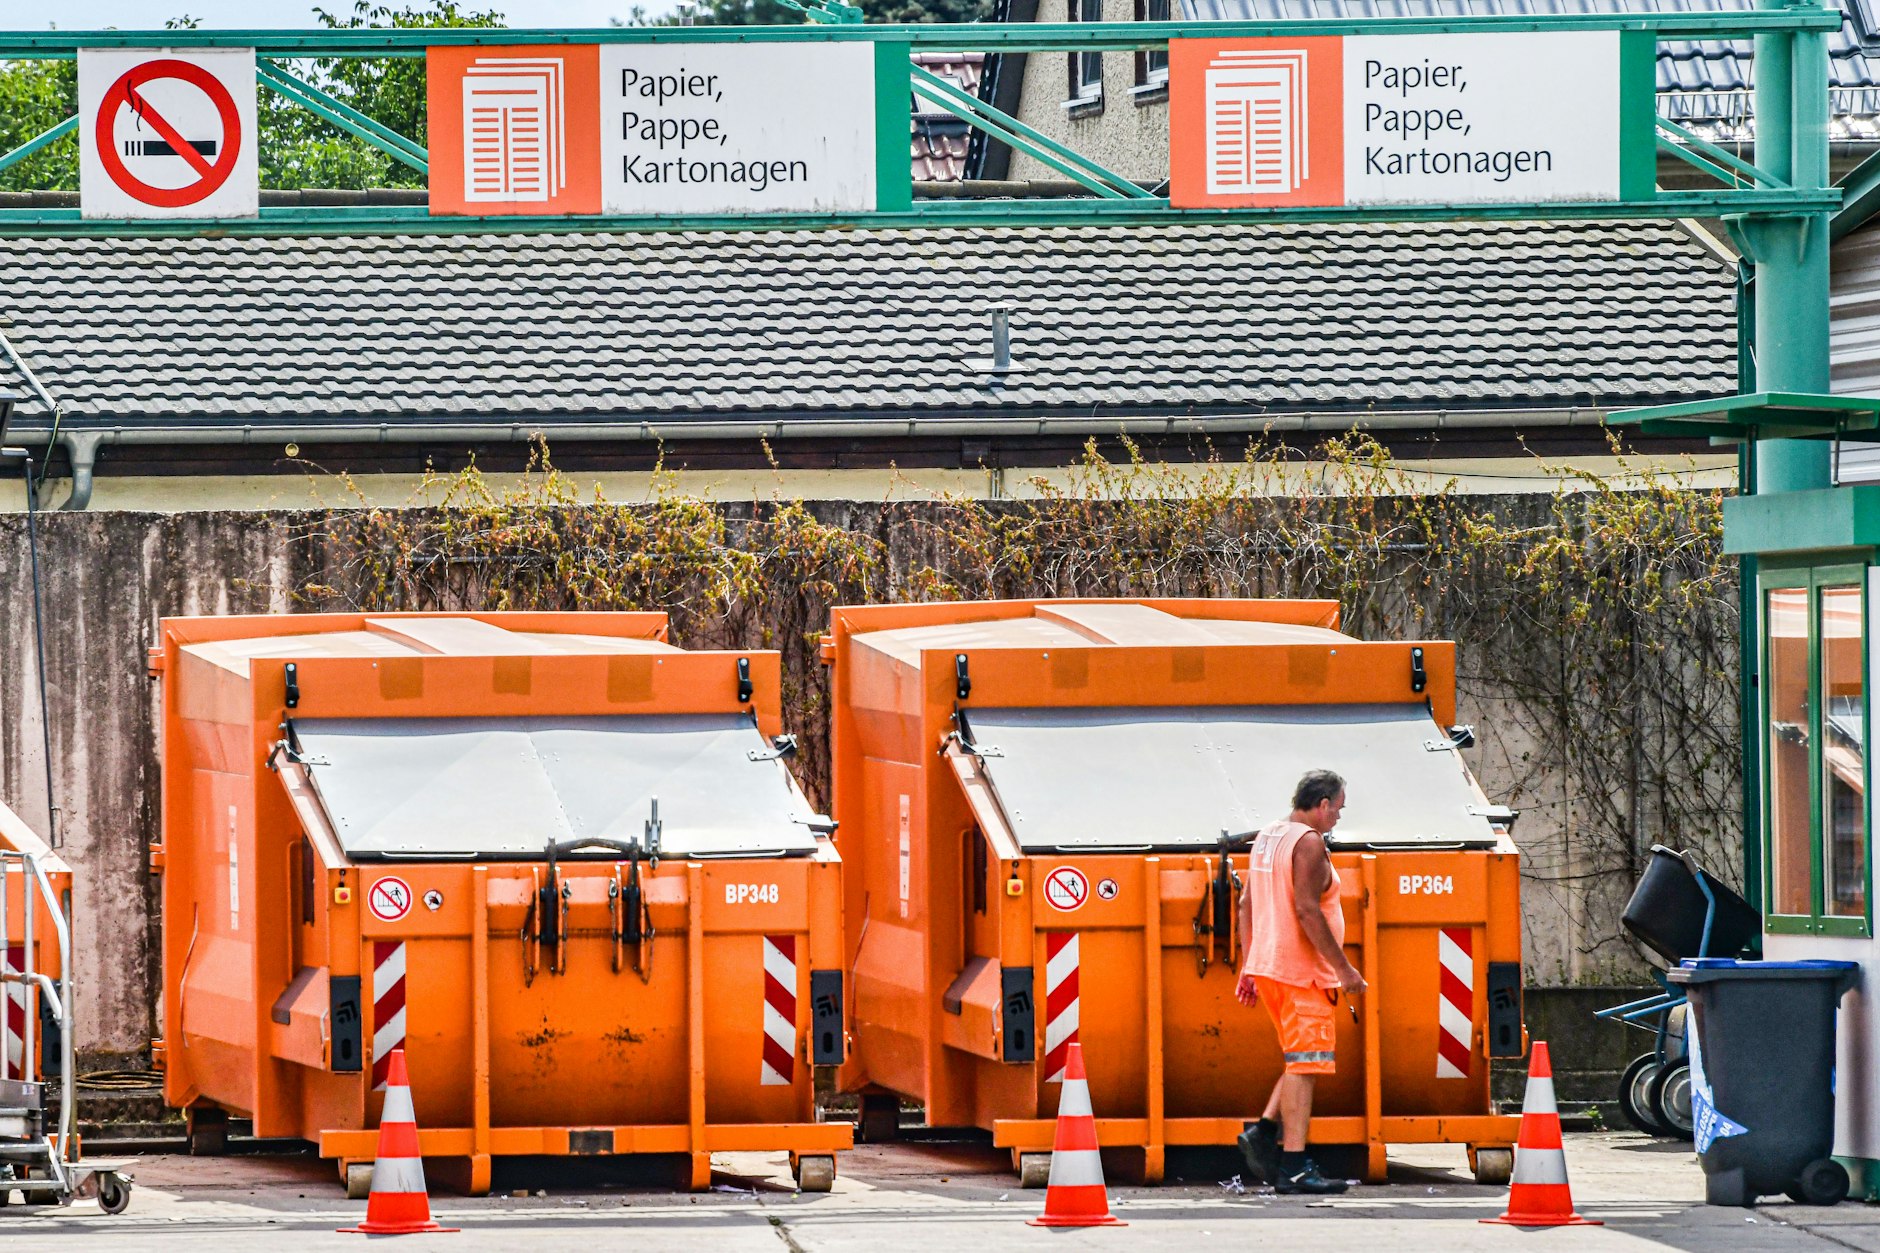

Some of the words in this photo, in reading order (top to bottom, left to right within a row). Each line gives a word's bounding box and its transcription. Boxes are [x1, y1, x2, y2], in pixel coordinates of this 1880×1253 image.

[622, 68, 723, 106] Papier,
[1366, 59, 1467, 97] Papier,
[623, 112, 727, 149] Pappe,
[1367, 104, 1471, 141] Pappe,
[624, 155, 807, 191] Kartonagen
[1367, 147, 1552, 182] Kartonagen
[725, 883, 779, 904] BP348
[1399, 874, 1454, 895] BP364
